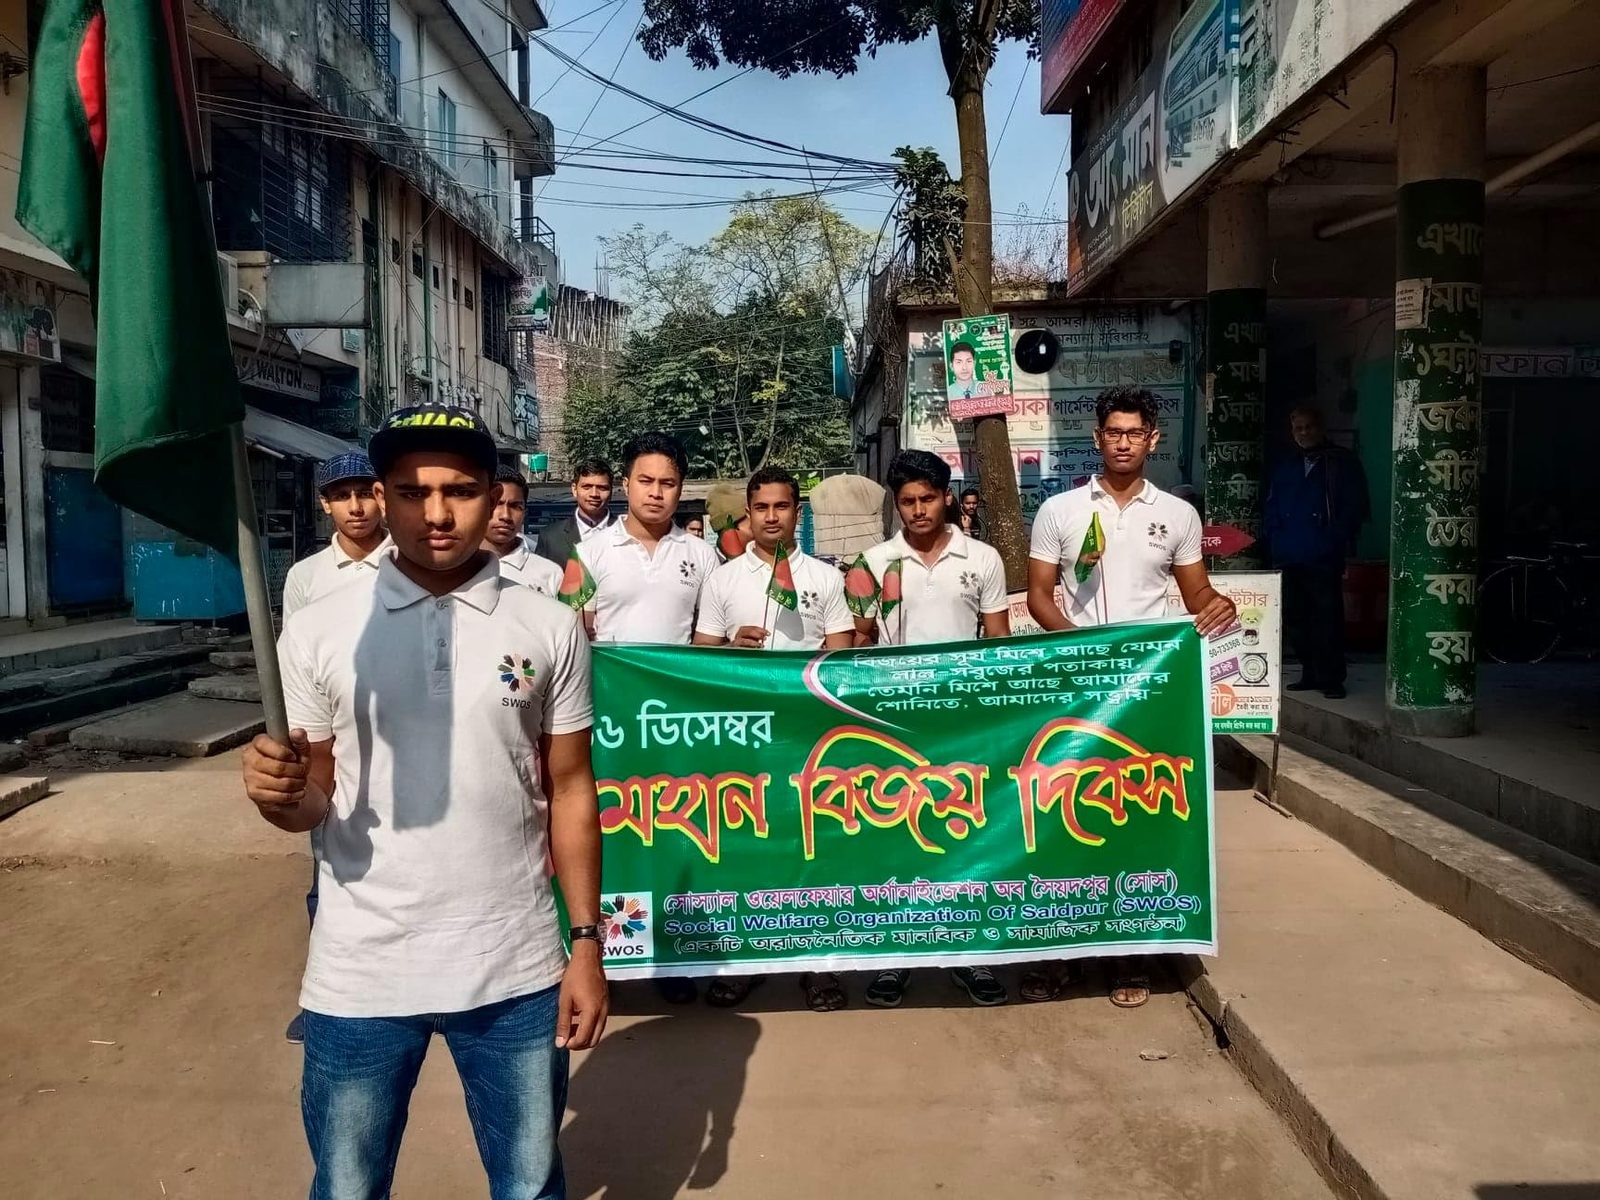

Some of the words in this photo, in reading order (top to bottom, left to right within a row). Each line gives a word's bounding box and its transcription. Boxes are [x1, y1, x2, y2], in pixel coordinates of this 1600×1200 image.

[256, 358, 302, 389] WALTON
[1054, 643, 1113, 657] আছে
[1121, 638, 1184, 653] যেমন
[867, 681, 941, 698] তেমনি
[948, 679, 999, 695] মিশে
[1007, 677, 1063, 691] আছে
[1071, 671, 1172, 687] আমাদের
[502, 697, 531, 709] SWOS
[978, 691, 1076, 706] আমাদের
[591, 715, 625, 750] ৬
[637, 698, 775, 749] ডিসেম্বর
[597, 768, 771, 863] মহান
[790, 725, 990, 861] বিজয়
[1008, 716, 1194, 855] দিবস
[993, 880, 1025, 901] অব
[1030, 874, 1109, 901] সৈয়দপুর
[664, 916, 735, 936] Social
[741, 913, 828, 932] Welfare
[834, 907, 981, 929] Organization
[987, 905, 1016, 922] Of
[1021, 901, 1108, 921] Saidpur
[1113, 895, 1201, 916] (SWOS)
[983, 927, 1001, 942] ও
[1007, 920, 1100, 942] সামাজিক
